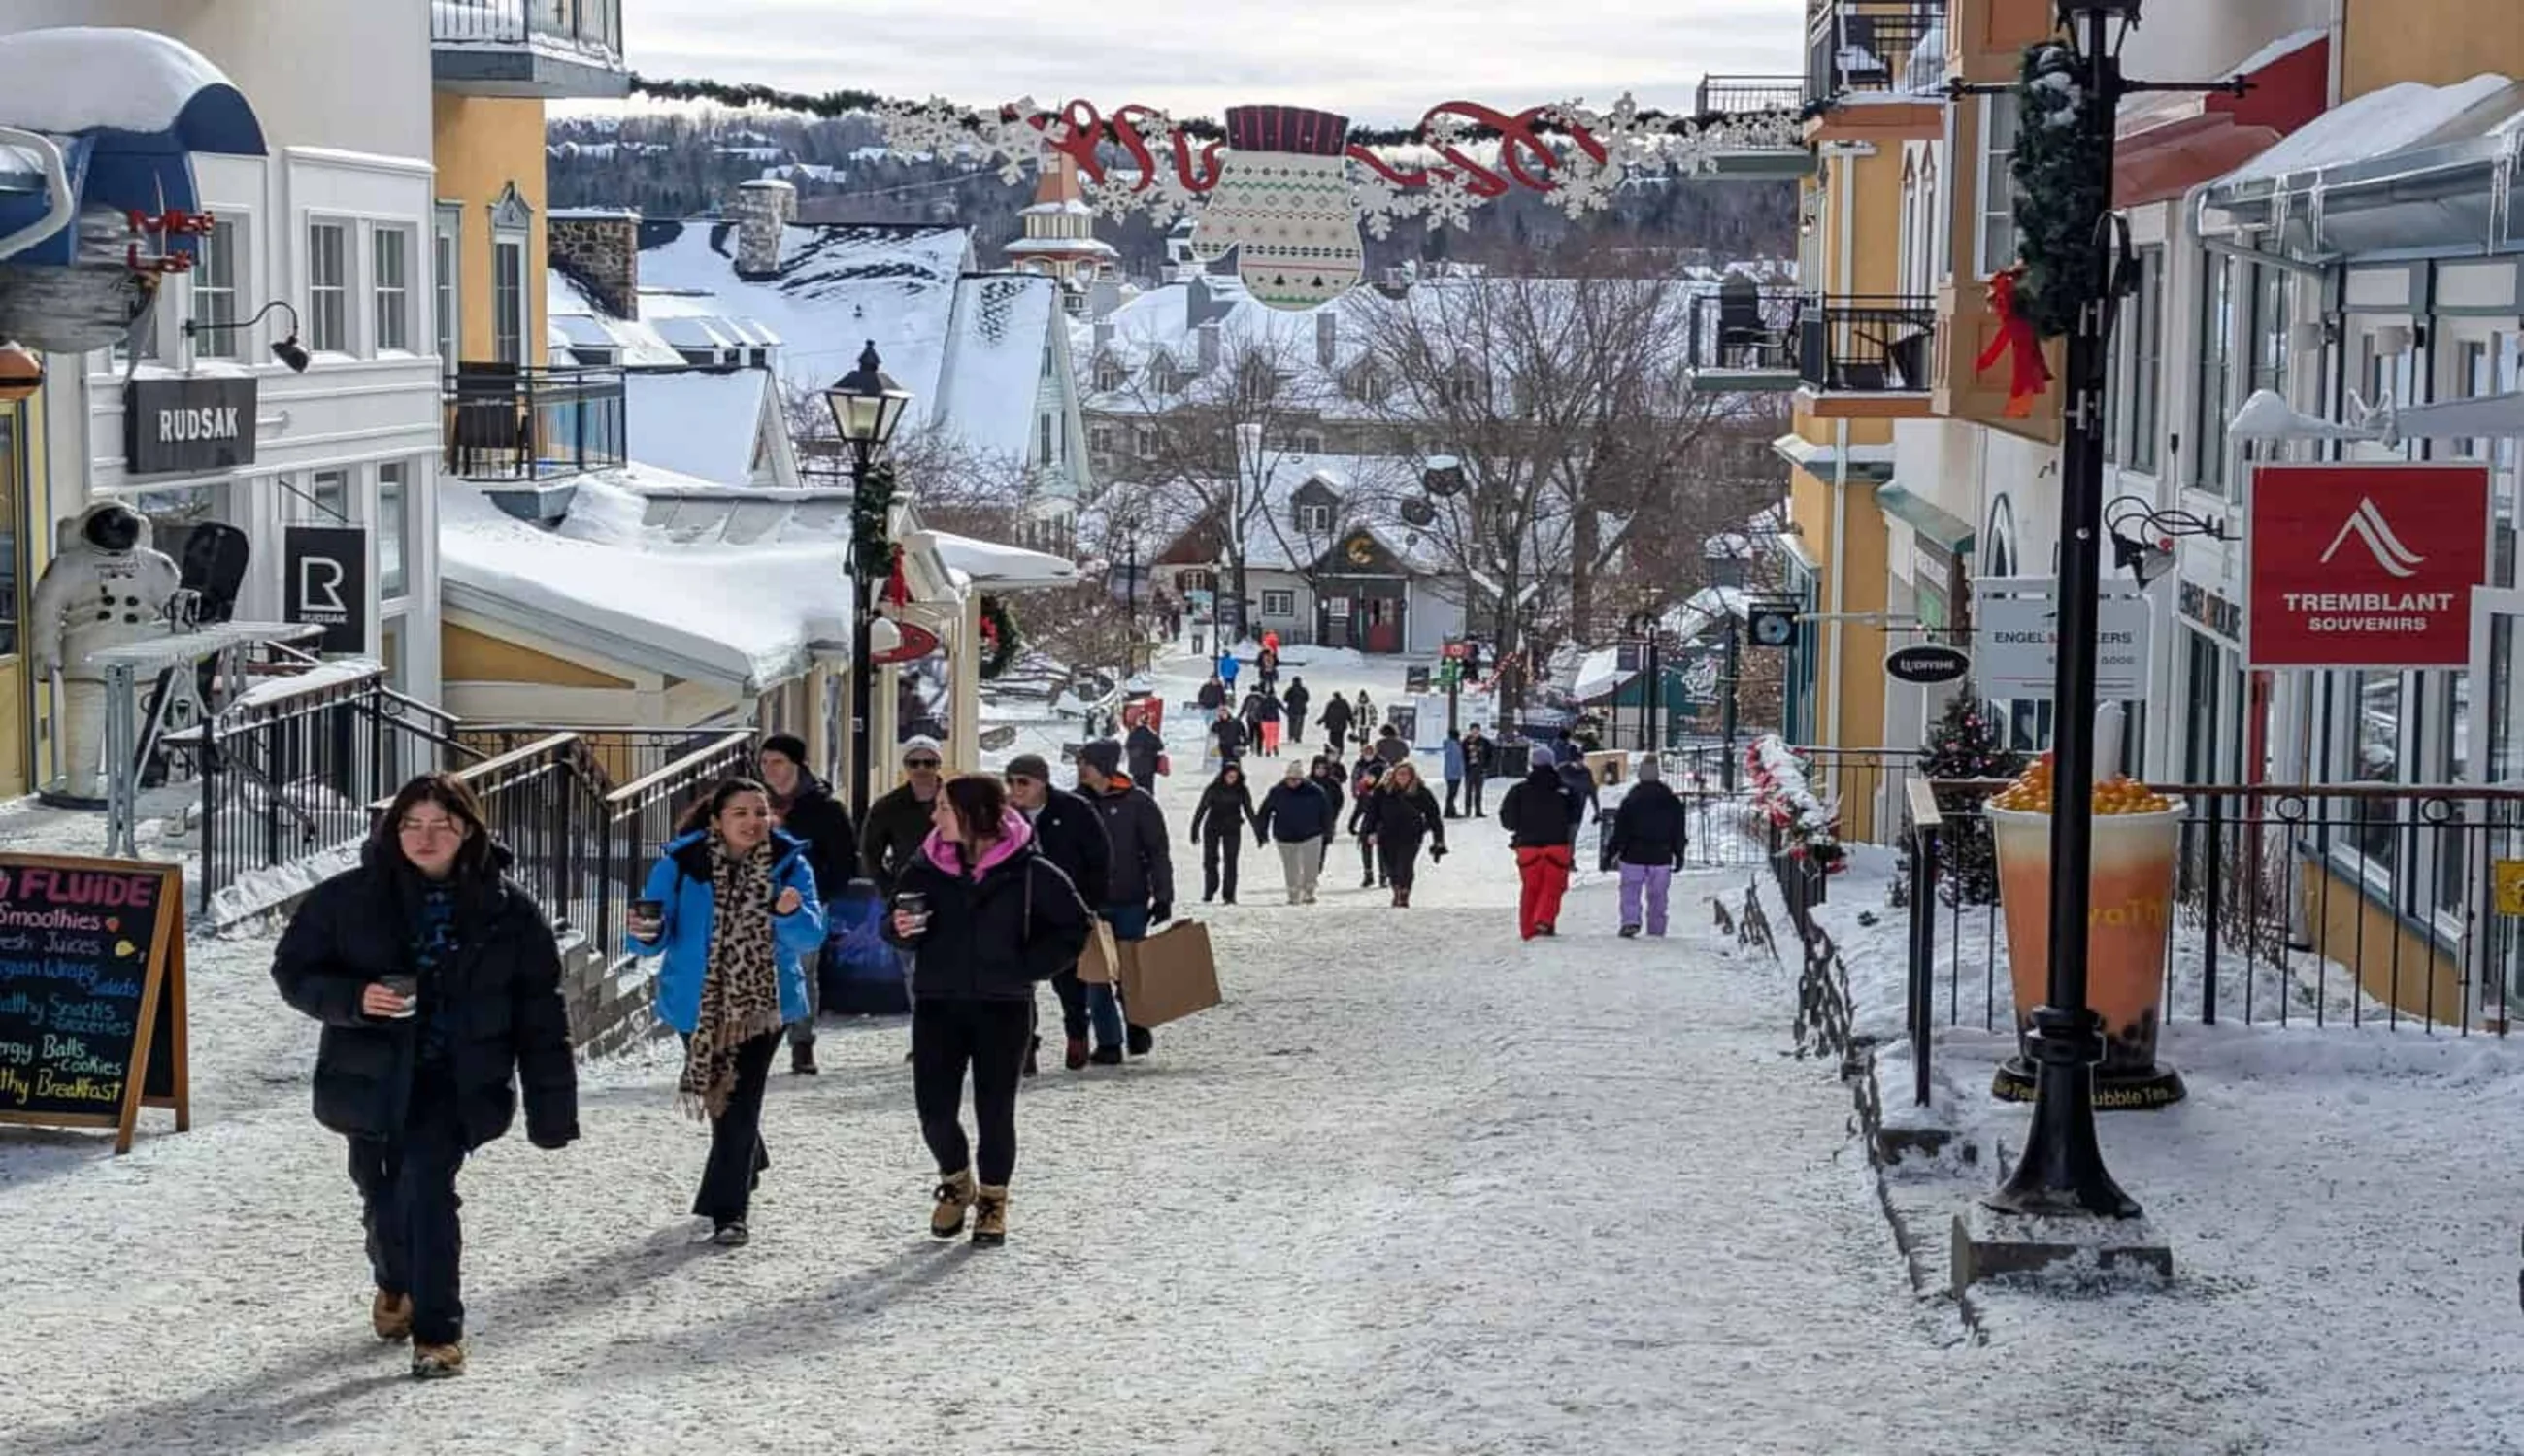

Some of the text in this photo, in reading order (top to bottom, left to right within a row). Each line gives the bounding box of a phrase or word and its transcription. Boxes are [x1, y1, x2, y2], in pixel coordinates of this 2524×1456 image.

[158, 406, 239, 443] RUDSAK
[299, 556, 348, 612] R
[2282, 592, 2455, 612] TREMBLANT
[299, 612, 347, 625] RUDSAK
[2308, 616, 2428, 631] SOUVENIRS
[44, 931, 102, 955] Juices
[42, 1033, 88, 1059] Balls
[35, 1068, 123, 1102] Breakfast
[2090, 1088, 2142, 1107] ubble
